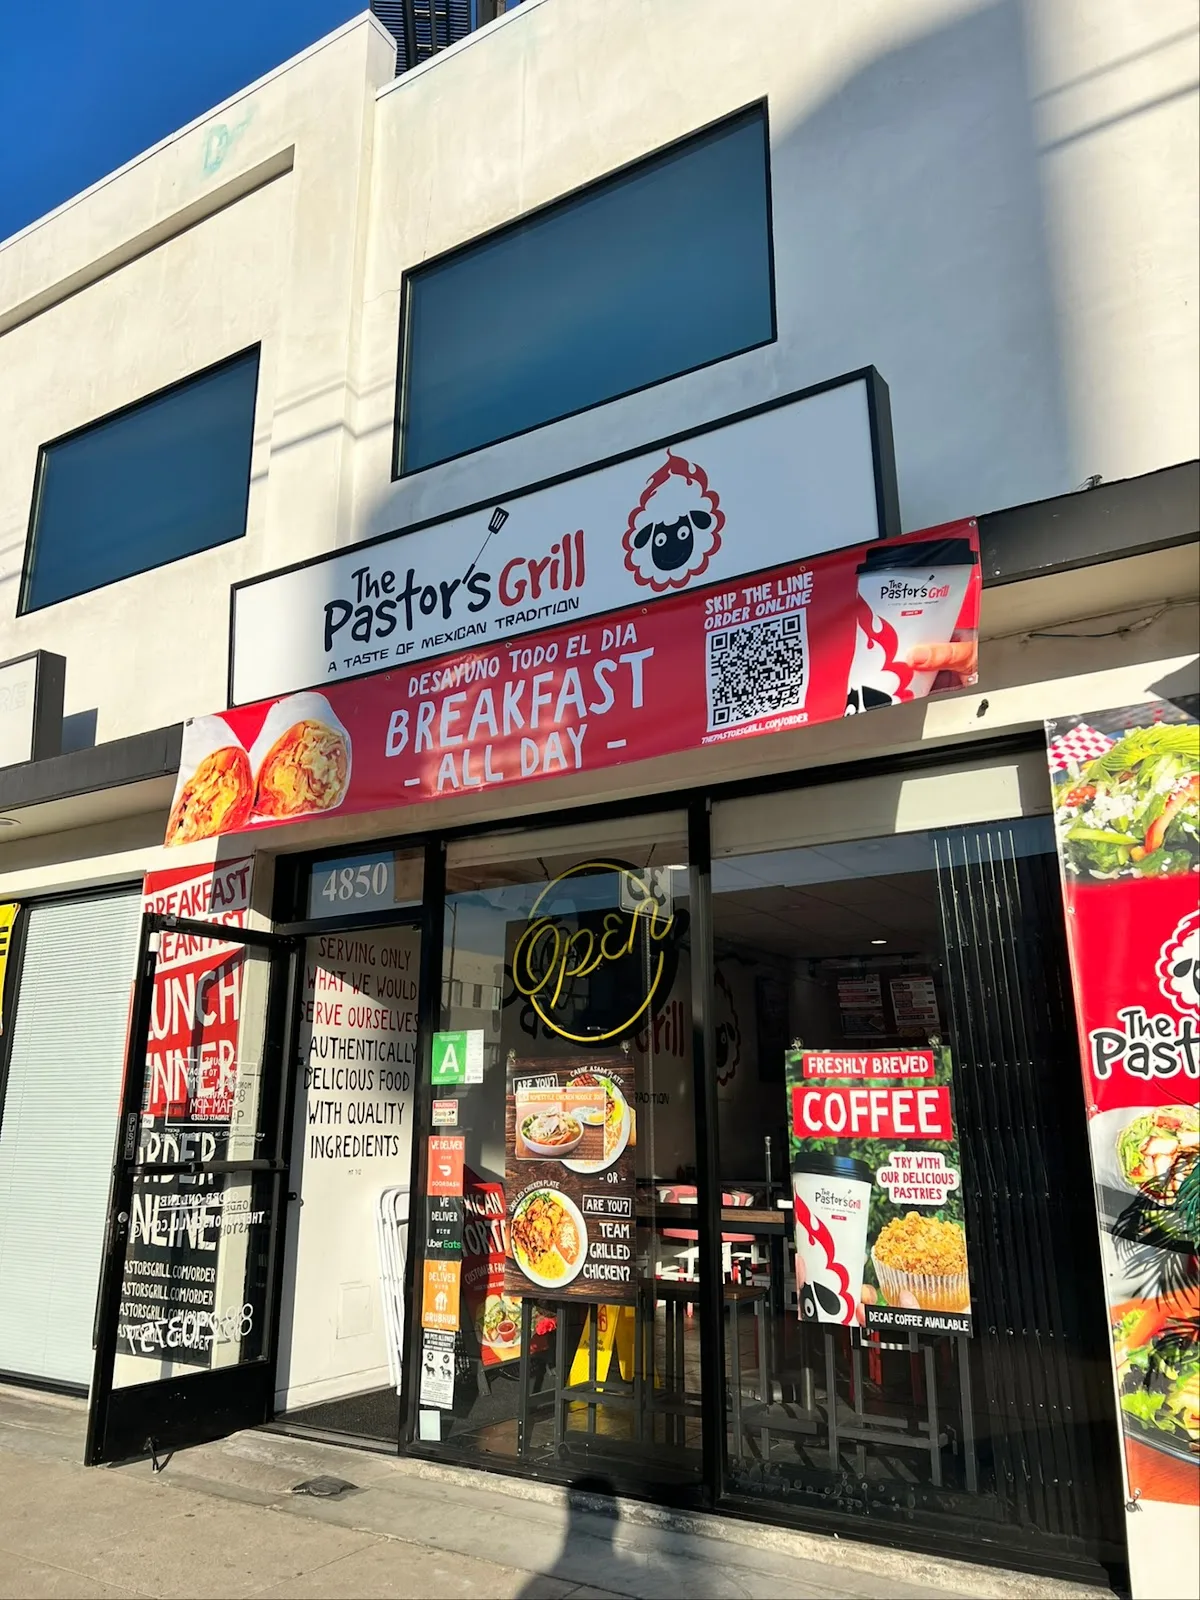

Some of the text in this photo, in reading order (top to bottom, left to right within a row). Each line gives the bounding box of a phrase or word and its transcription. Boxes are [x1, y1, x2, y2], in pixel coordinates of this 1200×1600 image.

[324, 529, 586, 652] Pastor's Grill
[351, 566, 395, 603] The
[705, 571, 814, 615] SKIP THE LINE
[881, 583, 951, 600] Pastor's Grill
[889, 579, 903, 590] The
[703, 589, 813, 631] ORDER ONLINE
[328, 596, 580, 673] A TASTE OF MEXICAN TRADITION
[408, 623, 638, 698] DESAYUNO TODO EL DIA
[385, 647, 655, 758] BREAKFAST
[436, 724, 588, 791] ALL DAY
[321, 861, 388, 902] 4850
[318, 937, 412, 971] SERVING ONLY
[307, 967, 418, 1001] WHAT WE WOULD
[300, 1001, 419, 1033] SERVE OURSELVES
[1122, 1009, 1173, 1040] The
[309, 1036, 418, 1064] AUTHENTICALLY
[440, 1043, 459, 1074] A
[1094, 1020, 1200, 1077] Past
[808, 1056, 929, 1074] FRESHLY BREWED
[304, 1067, 411, 1092] DELICIOUS FOOD
[309, 1101, 342, 1126] WITH
[348, 1101, 405, 1125] QUALITY
[803, 1089, 942, 1133] COFFEE
[310, 1135, 400, 1160] INGREDIENTS
[431, 1140, 463, 1150] WE DELIVER
[893, 1156, 940, 1170] TRY WITH
[432, 1180, 460, 1188] DOORDASH
[525, 1181, 543, 1193] CHICKEN
[543, 1179, 560, 1189] PLATE
[607, 1172, 618, 1183] OR
[881, 1171, 954, 1185] OUR DELICIOUS
[439, 1197, 450, 1208] WE
[463, 1192, 504, 1218] XICAN
[893, 1187, 942, 1200] PASTRIES
[431, 1211, 458, 1222] DELIVER
[586, 1199, 628, 1213] ARE YOU?
[599, 1222, 630, 1239] TEAM
[427, 1238, 461, 1249] Uber Eats
[589, 1243, 631, 1260] GRILLED
[124, 1260, 216, 1283] ASTORSGRILL.COM/ORDER
[429, 1270, 456, 1282] DELIVER
[438, 1261, 448, 1271] WE
[583, 1263, 631, 1281] CHICKEN?
[122, 1282, 214, 1305] ASTORSGRILL.COM/ORDER
[425, 1312, 456, 1325] GRUBHUB
[869, 1311, 969, 1332] DECAF COFFEE AVAILABLE
